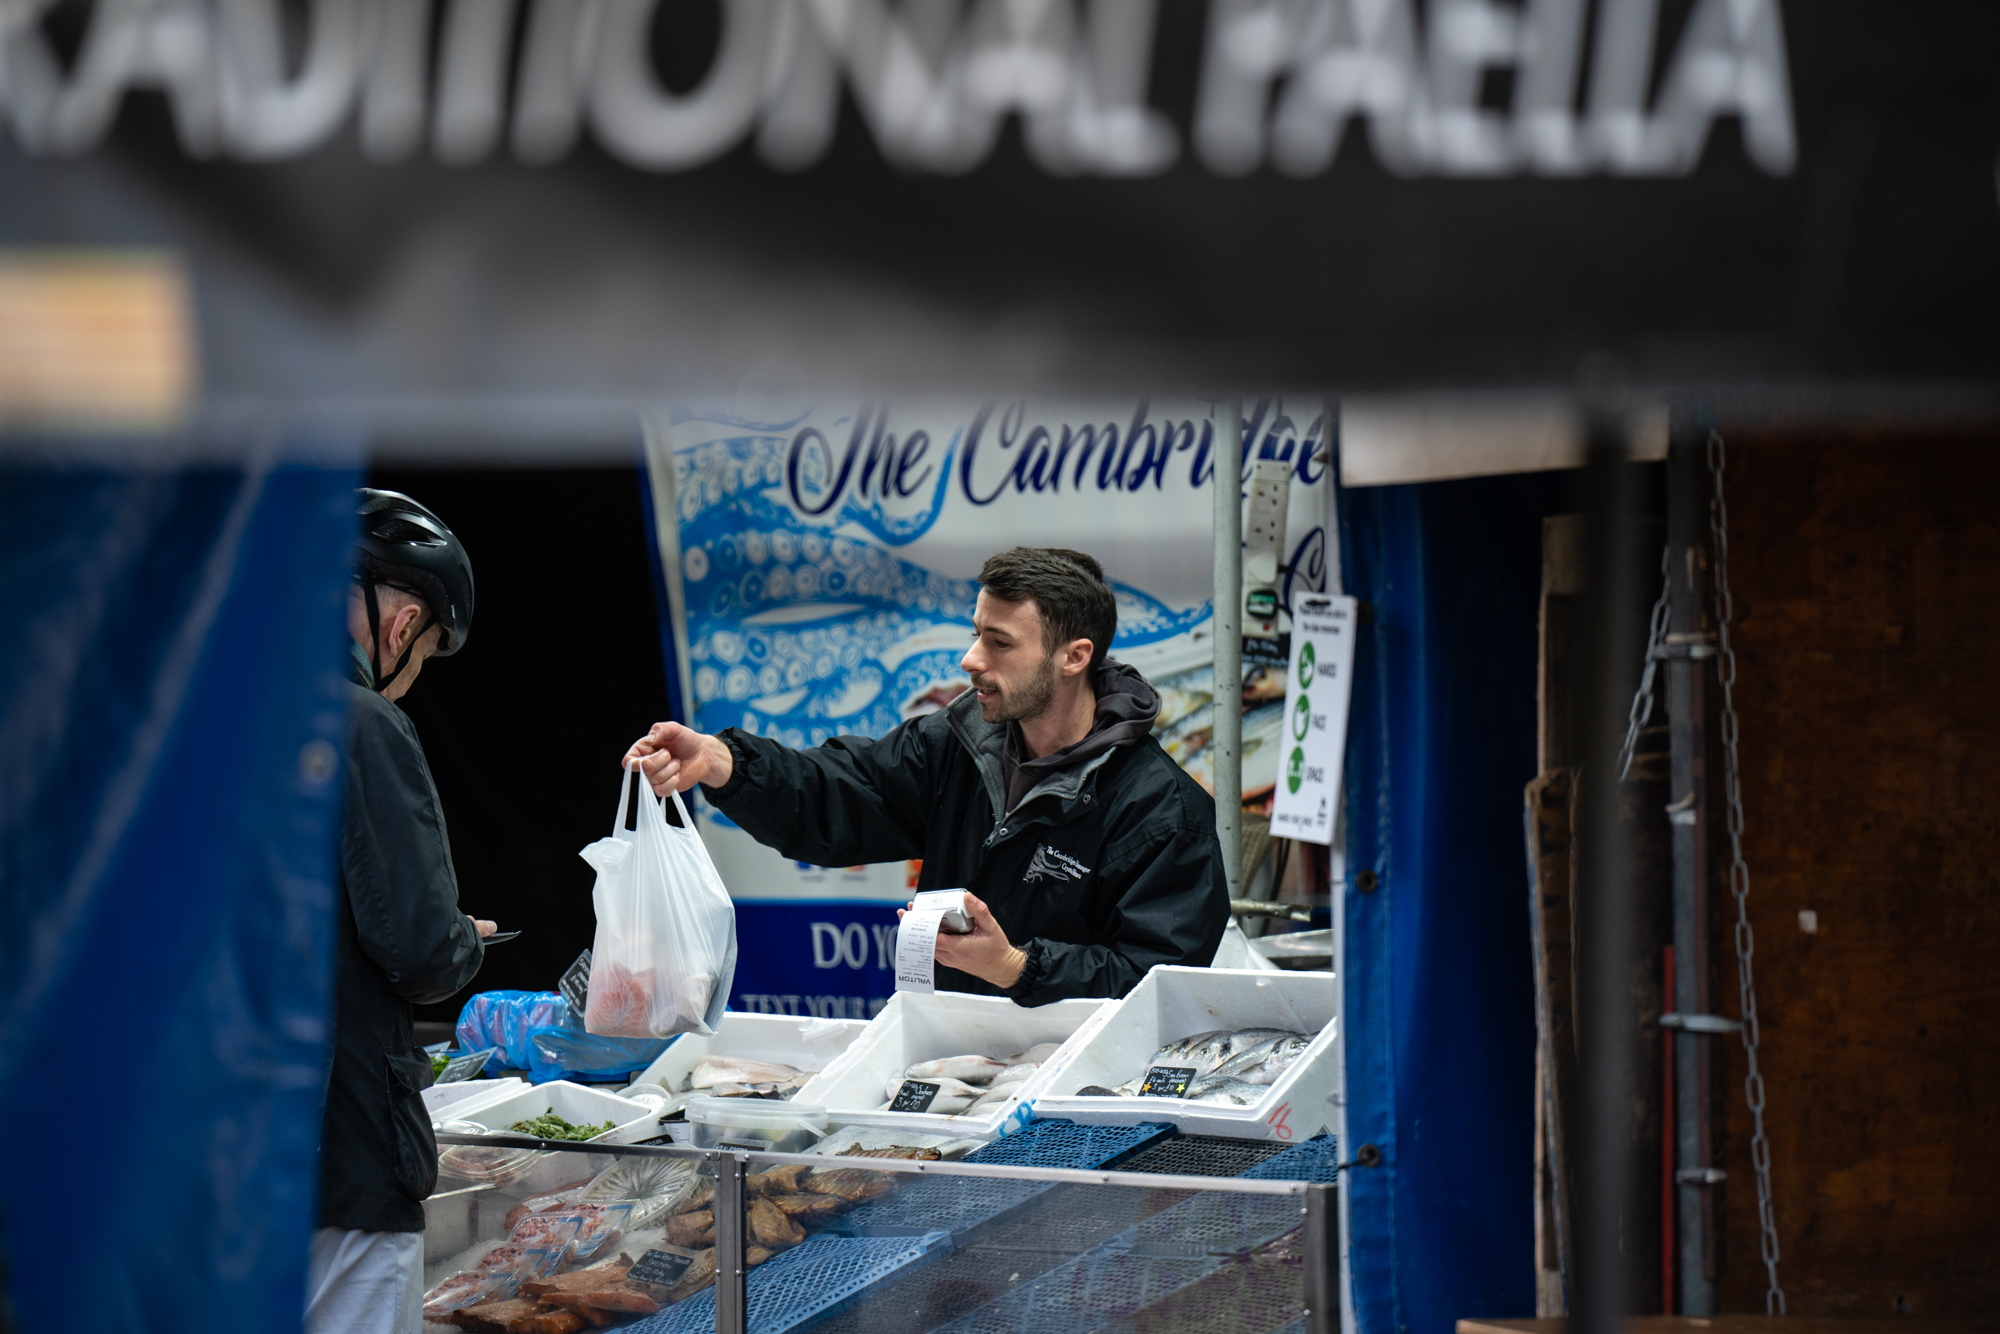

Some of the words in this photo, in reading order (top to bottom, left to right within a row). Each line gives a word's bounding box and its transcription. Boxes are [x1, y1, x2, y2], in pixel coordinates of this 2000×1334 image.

[1191, 0, 1798, 177] PAELLA
[787, 398, 933, 516] The
[810, 921, 869, 970] DO
[898, 975, 932, 985] VALITOR
[740, 994, 801, 1015] TEXT
[804, 994, 866, 1020] YOUR
